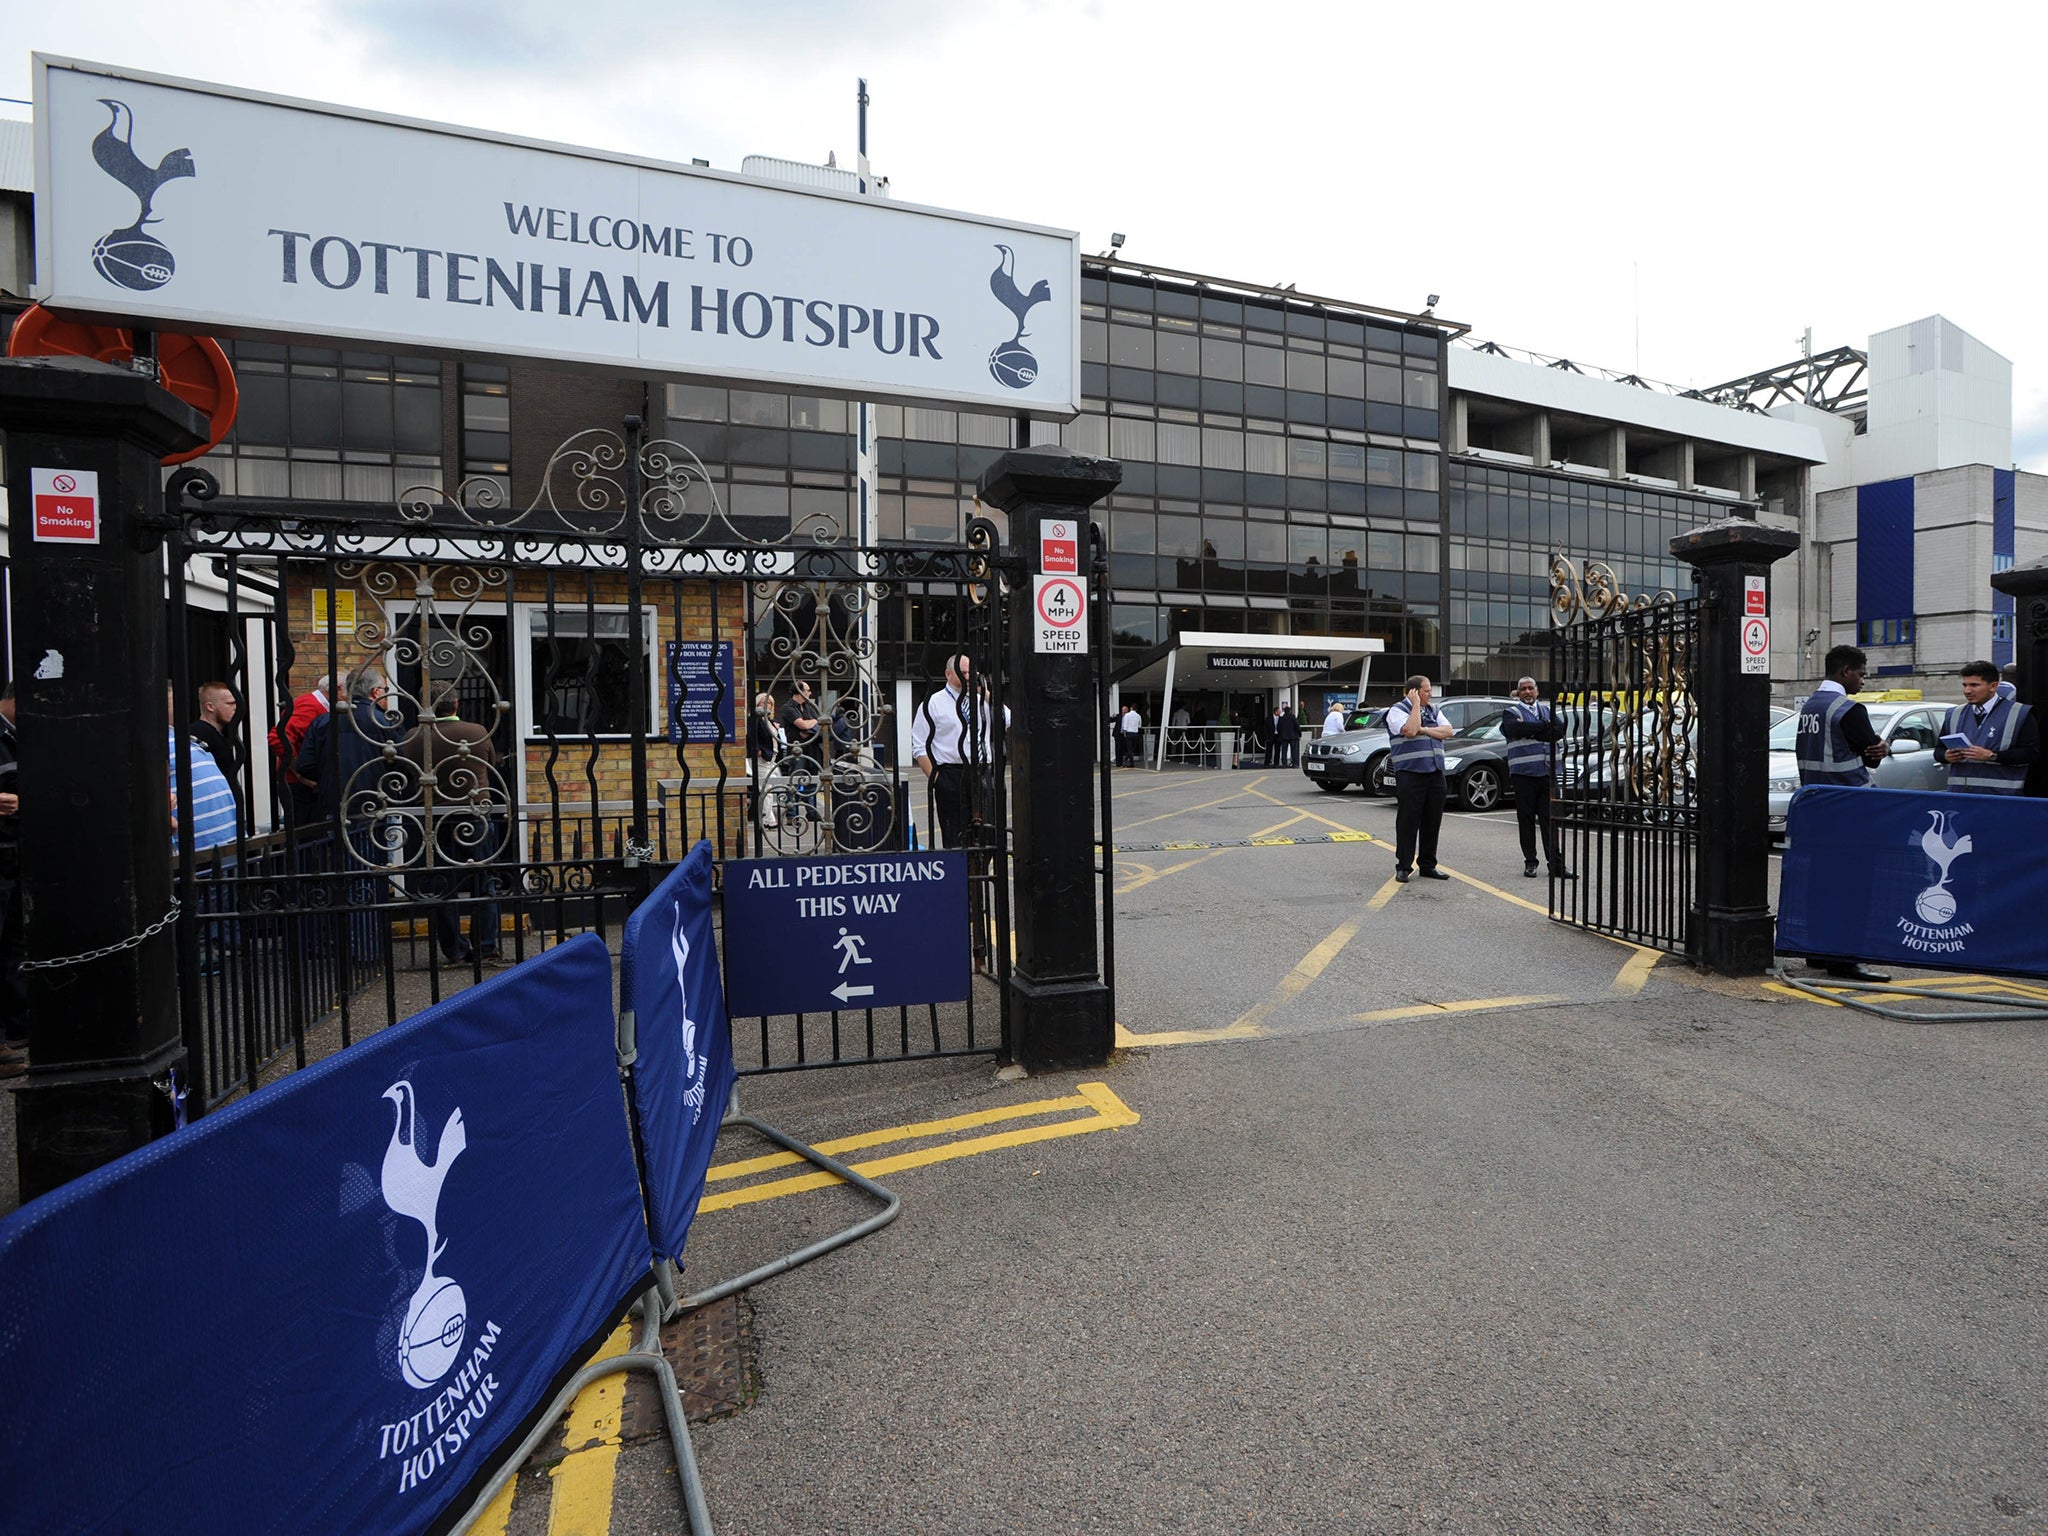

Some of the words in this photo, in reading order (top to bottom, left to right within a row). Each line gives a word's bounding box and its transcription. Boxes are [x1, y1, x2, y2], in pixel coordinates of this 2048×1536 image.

[503, 201, 695, 260] WELCOME
[706, 232, 753, 267] TO
[267, 228, 669, 328] TOTTENHAM
[691, 285, 944, 361] HOTSPUR
[56, 505, 74, 515] No
[40, 516, 92, 529] Smoking
[1053, 546, 1065, 554] No
[1044, 555, 1075, 565] Smoking
[1053, 588, 1066, 606] 4
[1048, 608, 1074, 617] MPH
[1042, 630, 1081, 641] SPEED
[1752, 626, 1759, 640] 4
[1045, 641, 1079, 651] LIMIT
[1212, 657, 1251, 667] WELCOME
[1252, 658, 1262, 667] TO
[1263, 659, 1288, 668] WHITE
[1288, 659, 1309, 669] HART
[1310, 660, 1329, 669] LANE
[1745, 656, 1767, 665] SPEED
[1746, 664, 1765, 672] LIMIT
[748, 868, 790, 889] ALL
[796, 860, 945, 887] PEDESTRIANS
[796, 895, 847, 918] THIS
[852, 893, 901, 915] WAY
[1896, 916, 1975, 940] TOTTENHAM
[1901, 935, 1966, 953] HOTSPUR
[379, 1320, 502, 1460] TOTTENHAM
[399, 1372, 499, 1494] HOTSPUR
